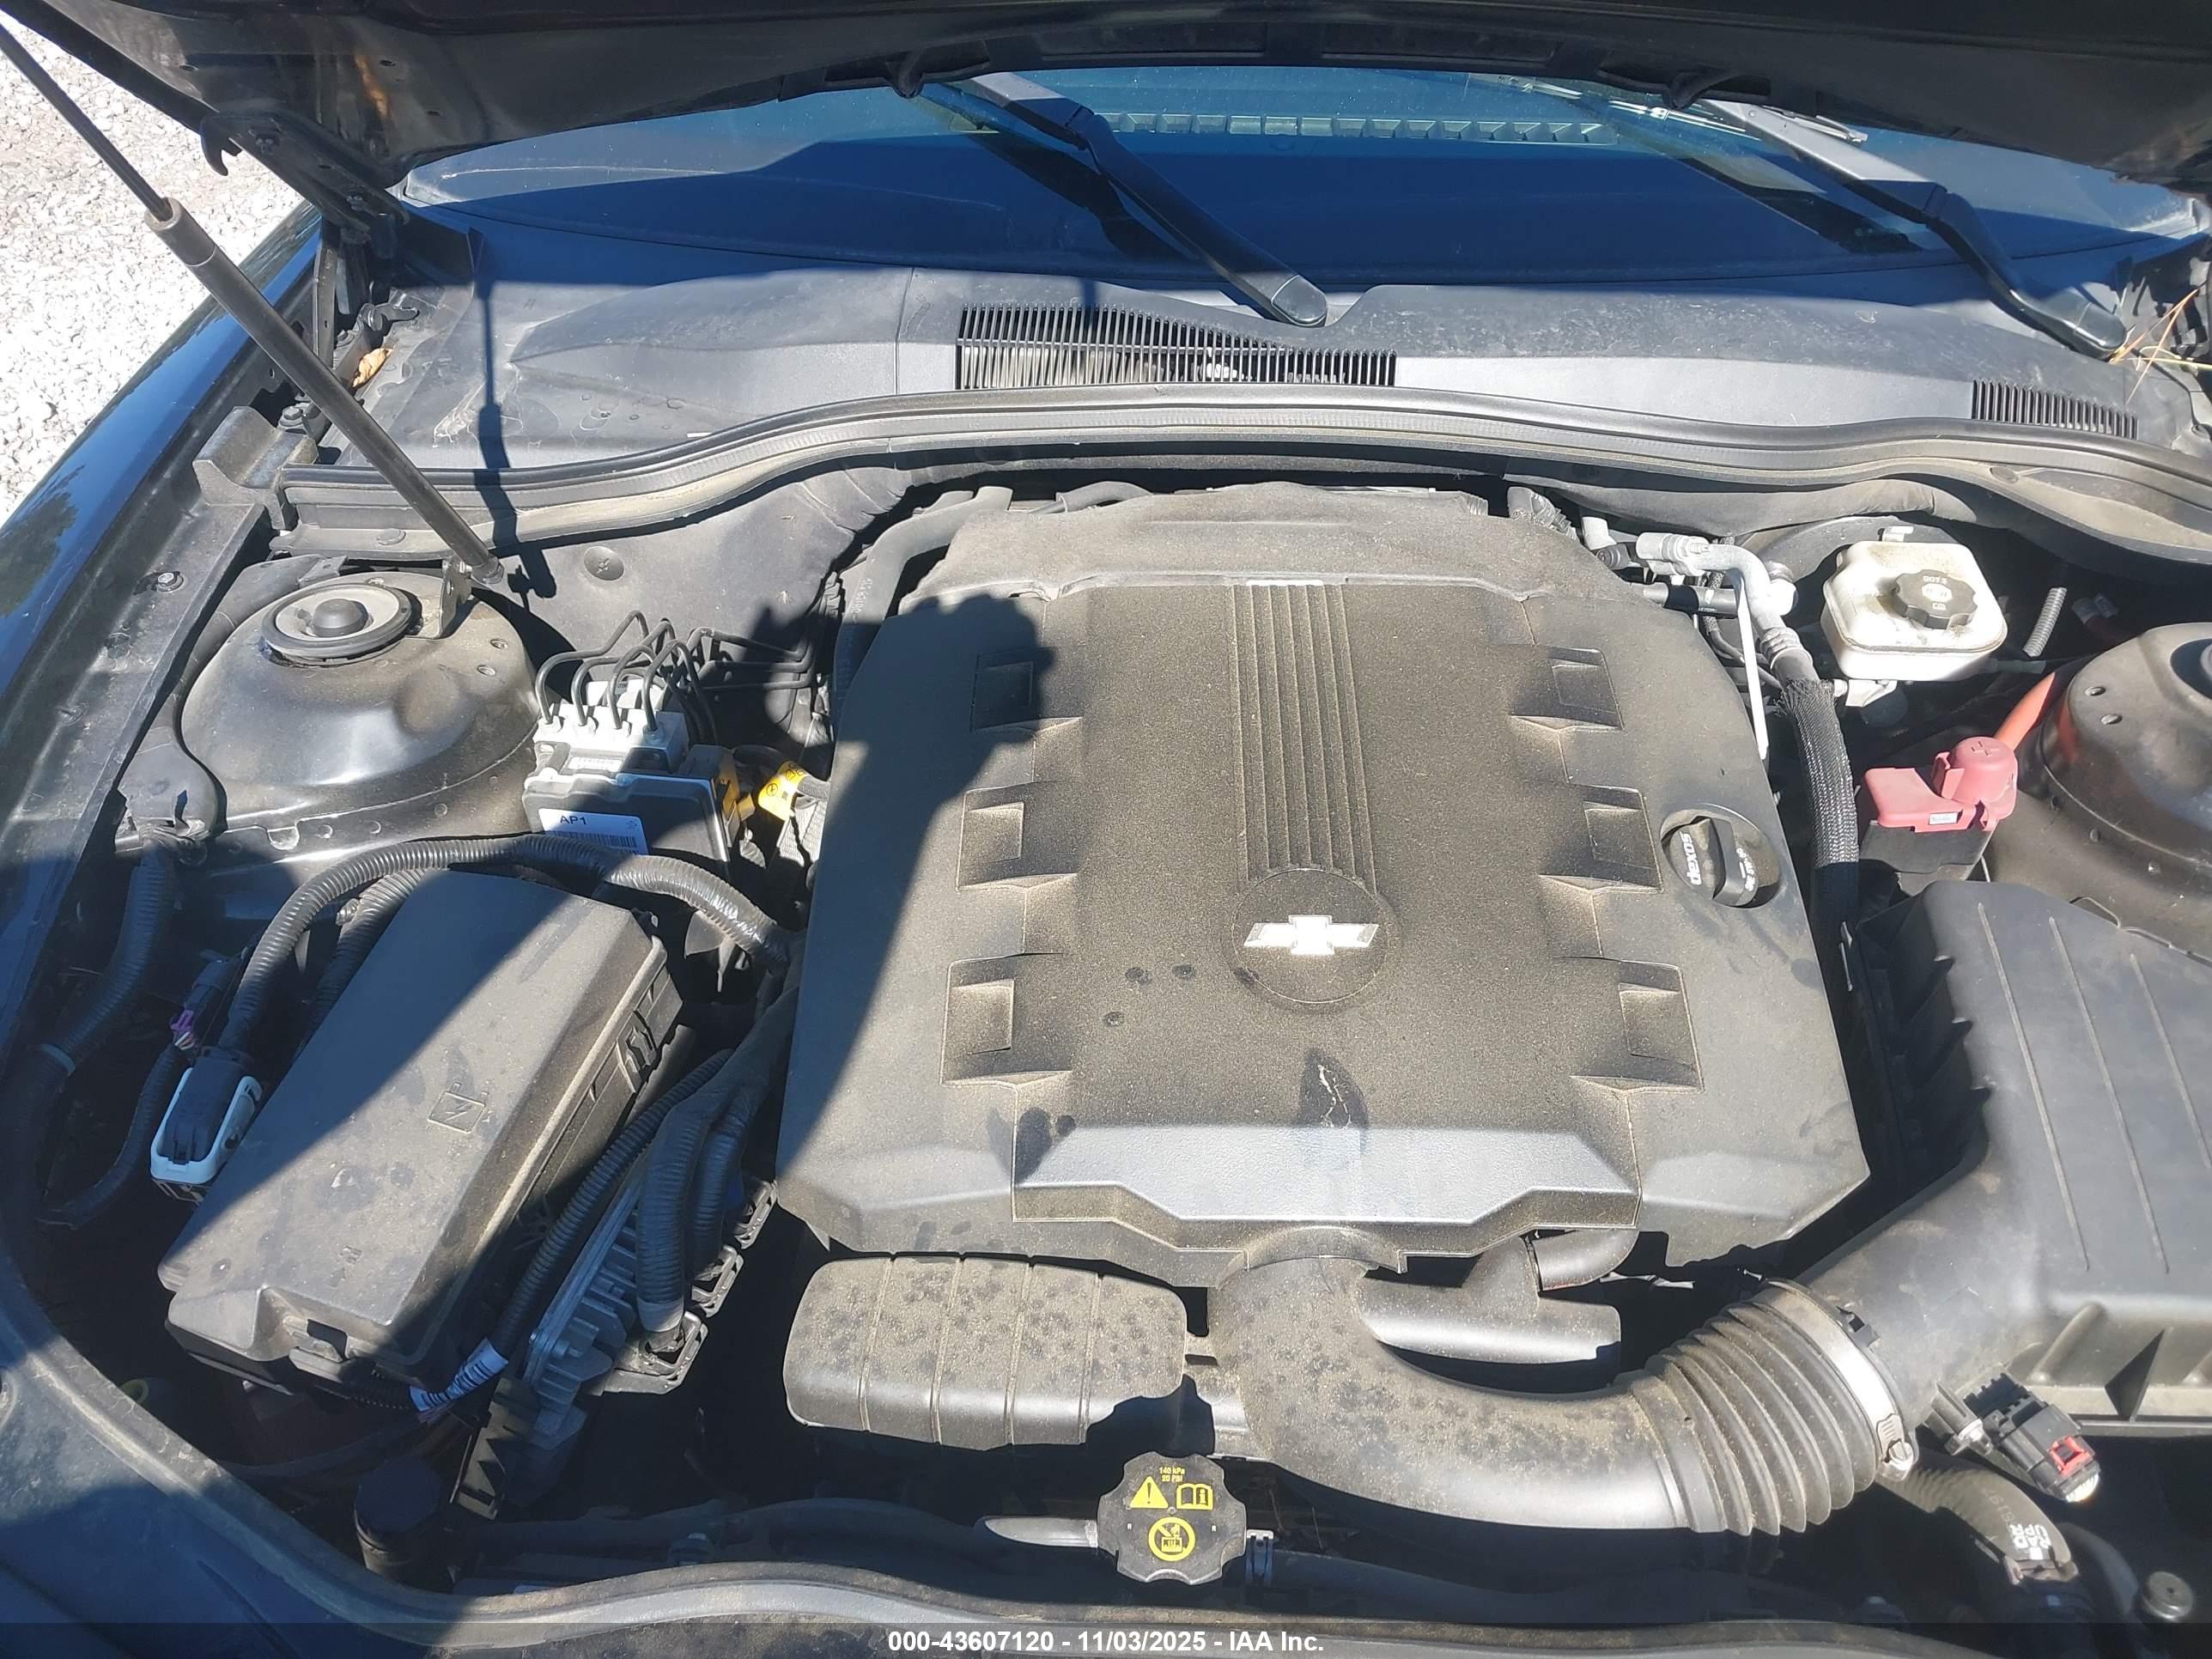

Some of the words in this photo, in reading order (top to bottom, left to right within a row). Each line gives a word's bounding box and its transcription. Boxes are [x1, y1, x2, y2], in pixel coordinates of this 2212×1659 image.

[560, 815, 586, 825] AP1
[1680, 831, 1702, 885] dexos
[1158, 1466, 1172, 1474] 140
[1172, 1466, 1185, 1475] kPa
[1171, 1474, 1183, 1483] PSI
[2009, 1523, 2048, 1537] UPR
[2012, 1535, 2051, 1549] RAD
